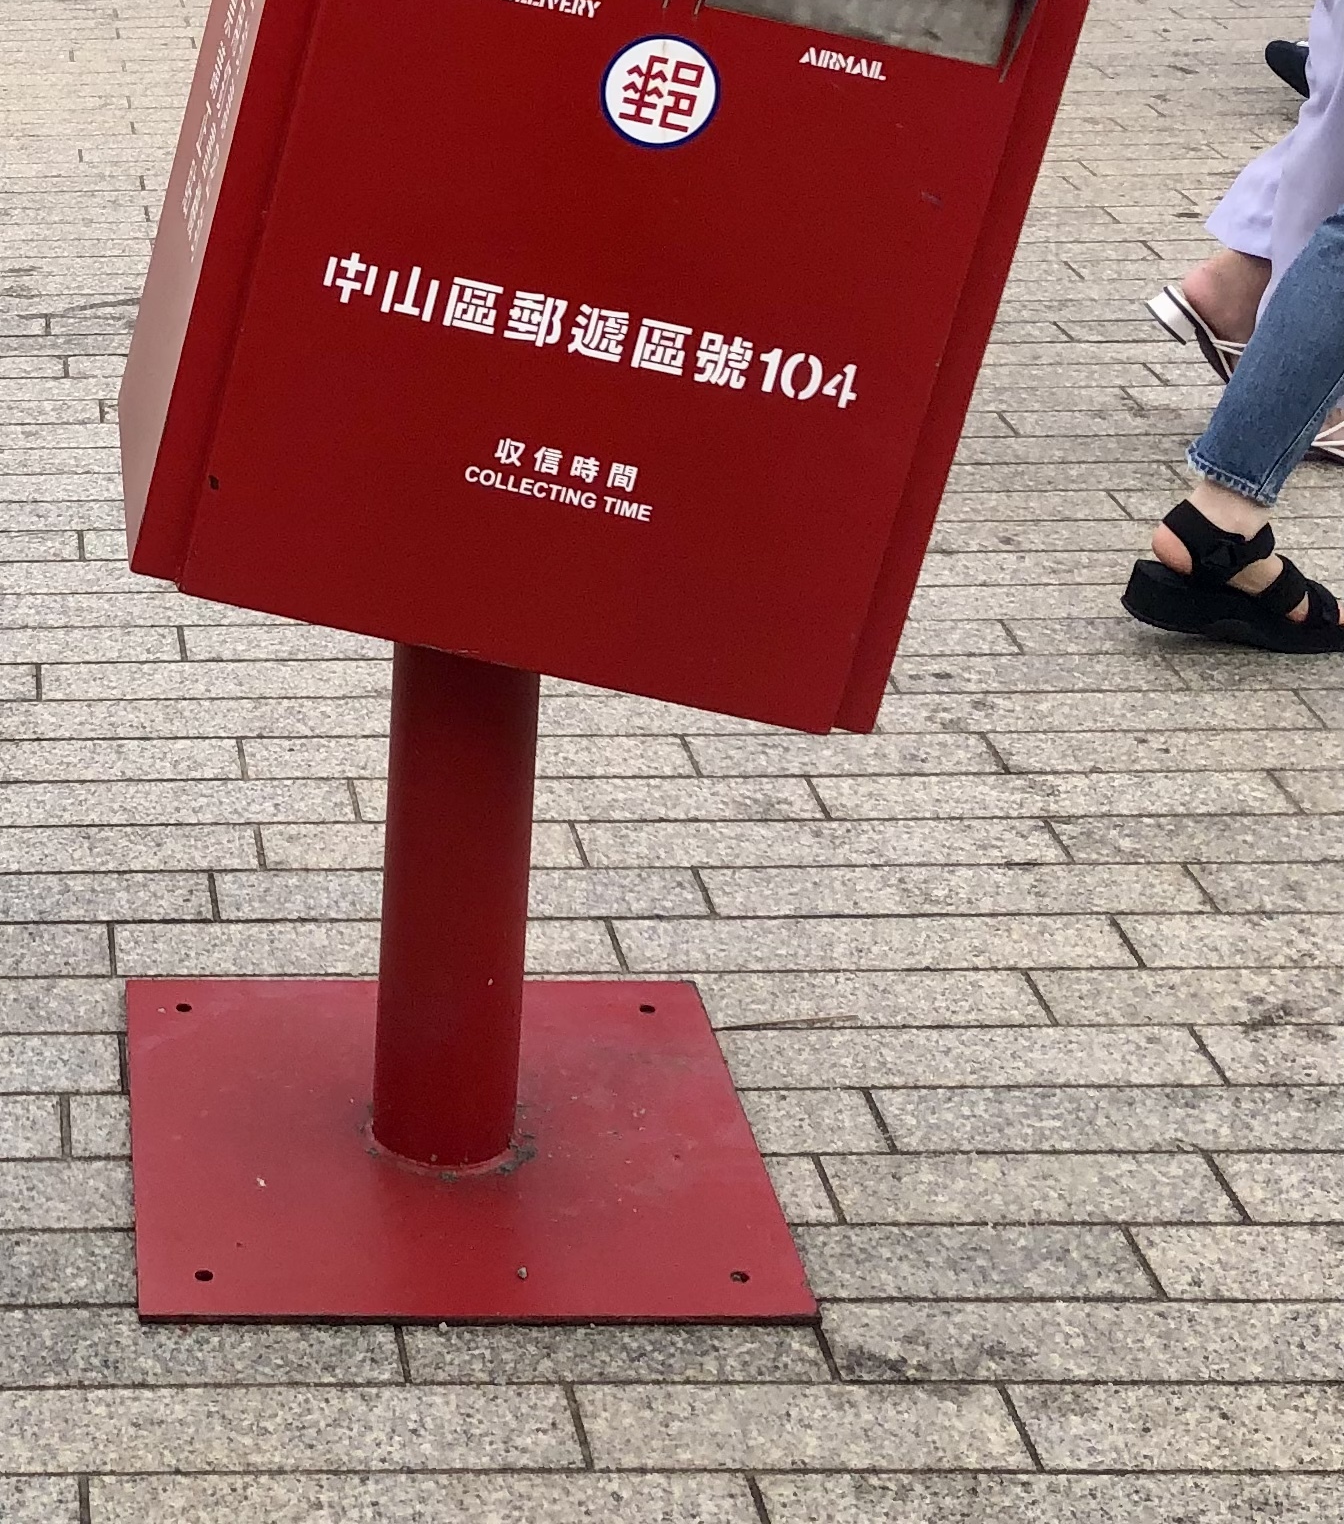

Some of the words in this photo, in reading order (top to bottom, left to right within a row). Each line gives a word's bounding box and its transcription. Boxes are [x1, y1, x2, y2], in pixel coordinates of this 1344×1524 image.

[799, 47, 886, 81] AIRMAIL
[323, 252, 857, 409] 中山區郵遞區號104
[464, 465, 597, 510] COLLECTING
[603, 496, 653, 522] TIME
